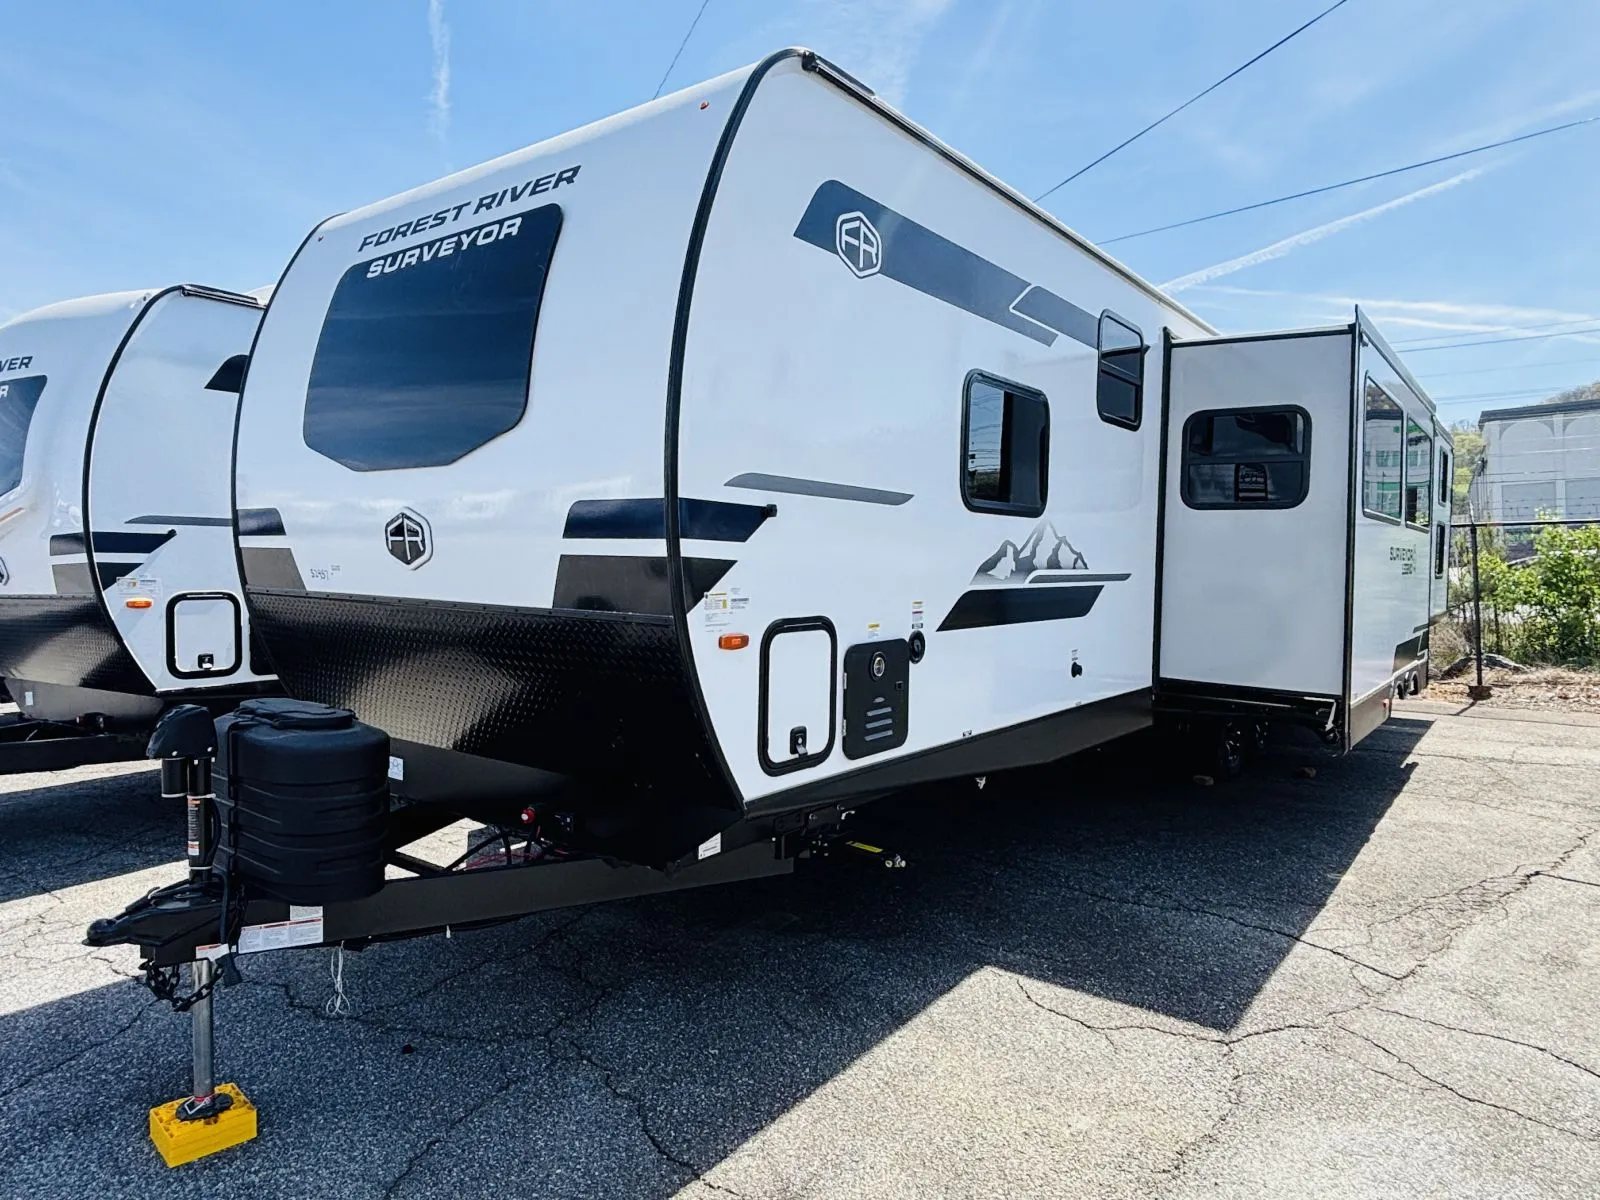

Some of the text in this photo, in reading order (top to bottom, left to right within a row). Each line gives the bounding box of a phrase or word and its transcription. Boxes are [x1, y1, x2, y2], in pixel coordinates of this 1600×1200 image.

[358, 165, 582, 253] FOREST RIVER
[366, 216, 522, 279] SURVEYOR
